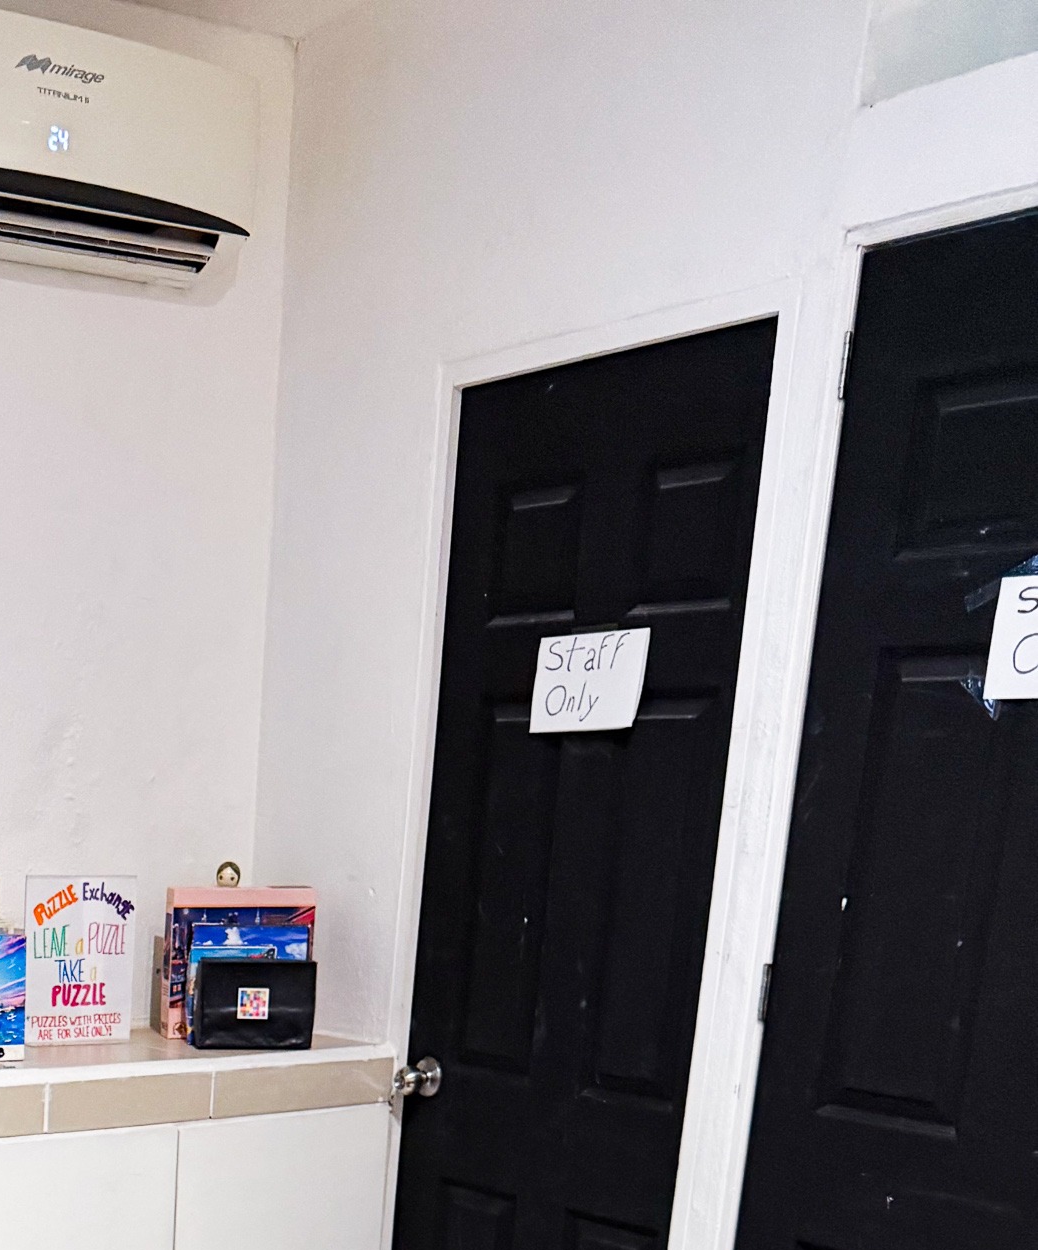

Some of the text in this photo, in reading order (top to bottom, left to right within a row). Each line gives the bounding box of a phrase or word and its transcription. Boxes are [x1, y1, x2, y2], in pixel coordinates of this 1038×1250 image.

[49, 63, 105, 84] mirage
[48, 125, 69, 152] 24
[545, 631, 630, 672] Staff
[545, 680, 599, 722] Only
[33, 921, 127, 959] LEAVE a PUZZLE
[54, 958, 86, 983] TAKE
[51, 982, 107, 1007] PUZZLE
[69, 1014, 92, 1026] WITH
[93, 1012, 121, 1025] PRICES
[38, 1024, 113, 1040] ARE FOR SALE ONLY!
